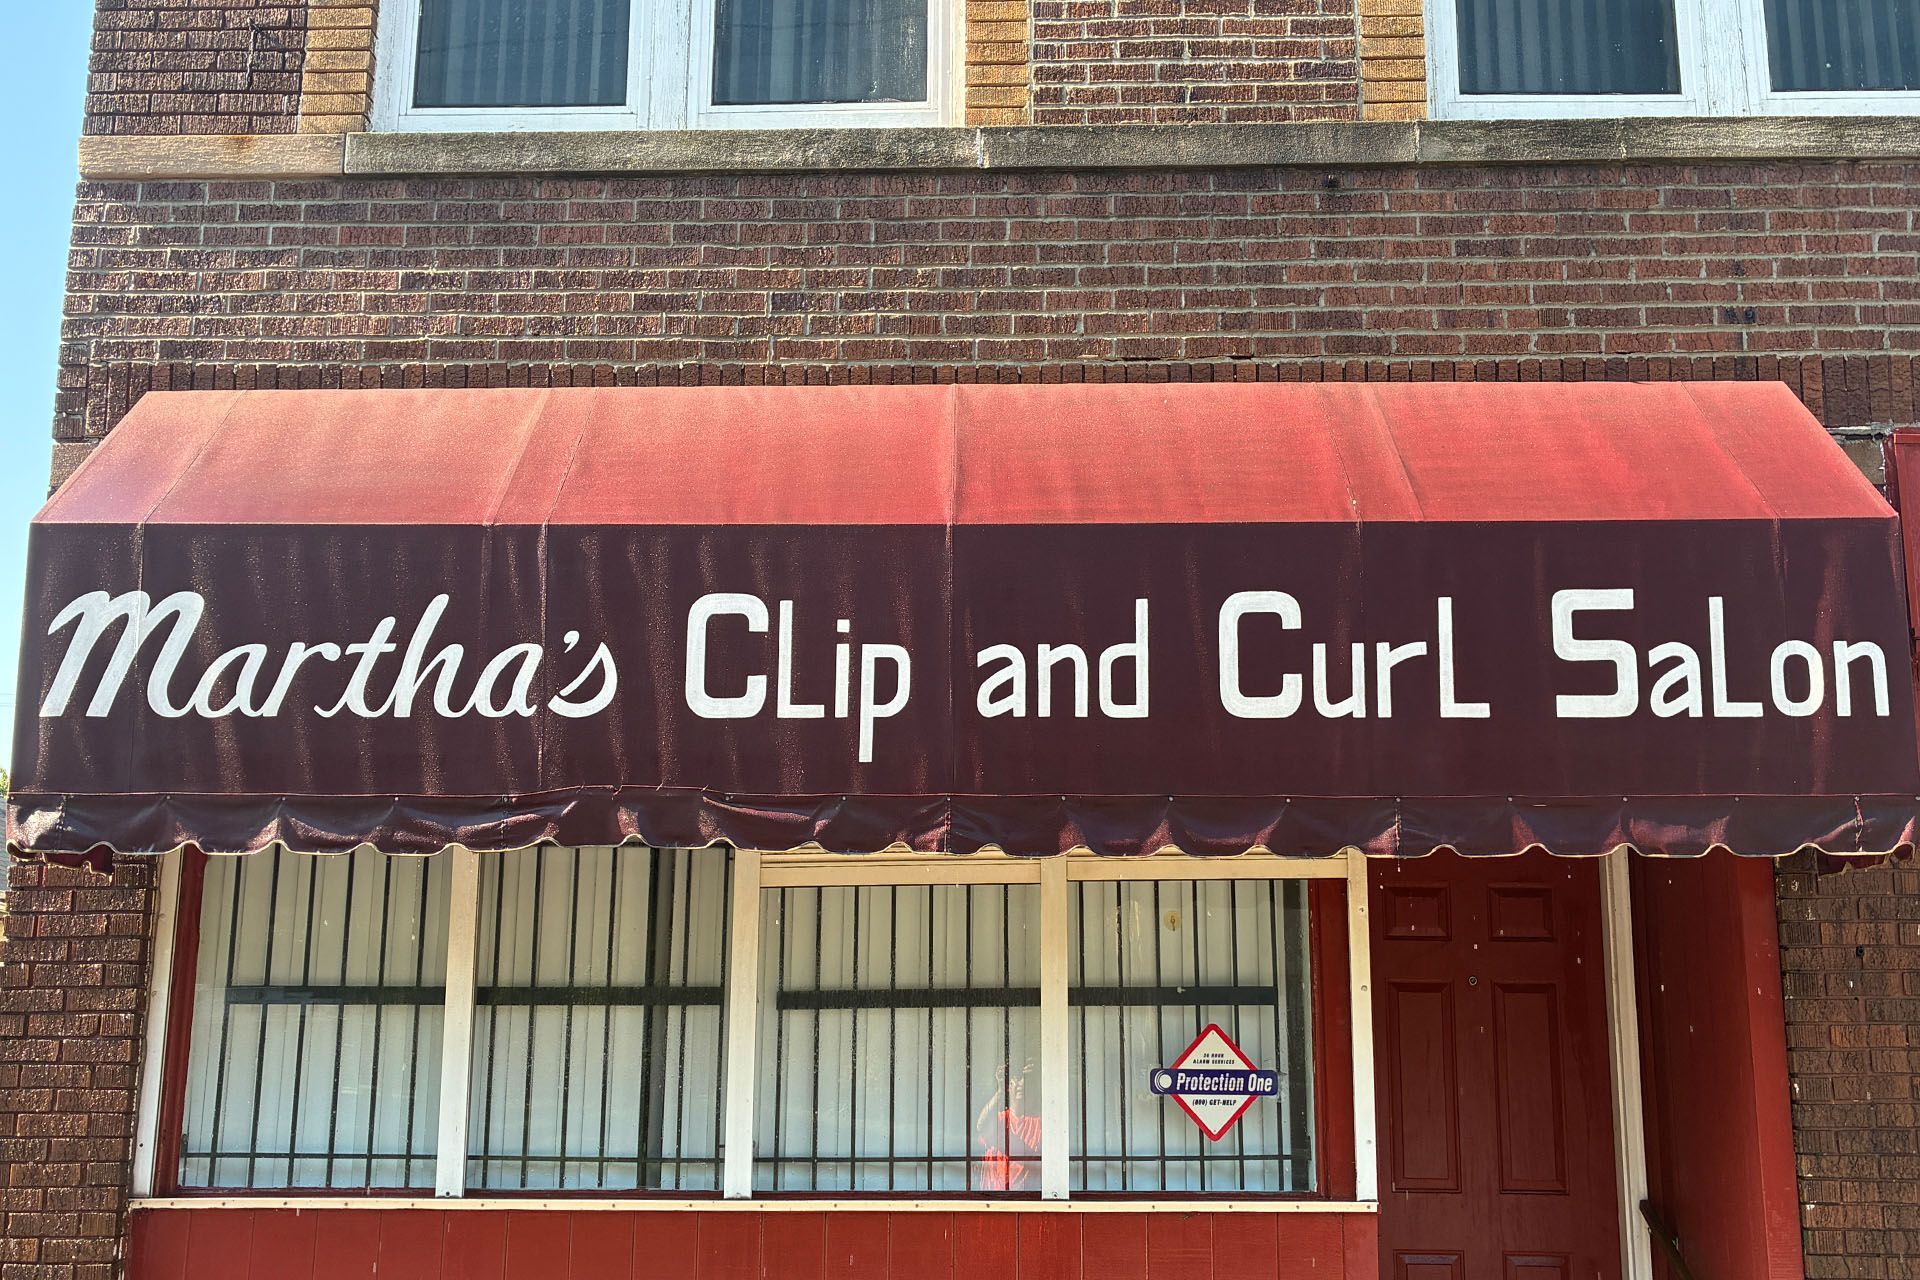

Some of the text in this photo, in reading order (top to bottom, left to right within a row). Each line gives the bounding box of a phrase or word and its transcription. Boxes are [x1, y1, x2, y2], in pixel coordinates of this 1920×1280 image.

[38, 590, 618, 719] Martha's
[975, 597, 1150, 720] and
[1176, 1072, 1273, 1093] Protection One
